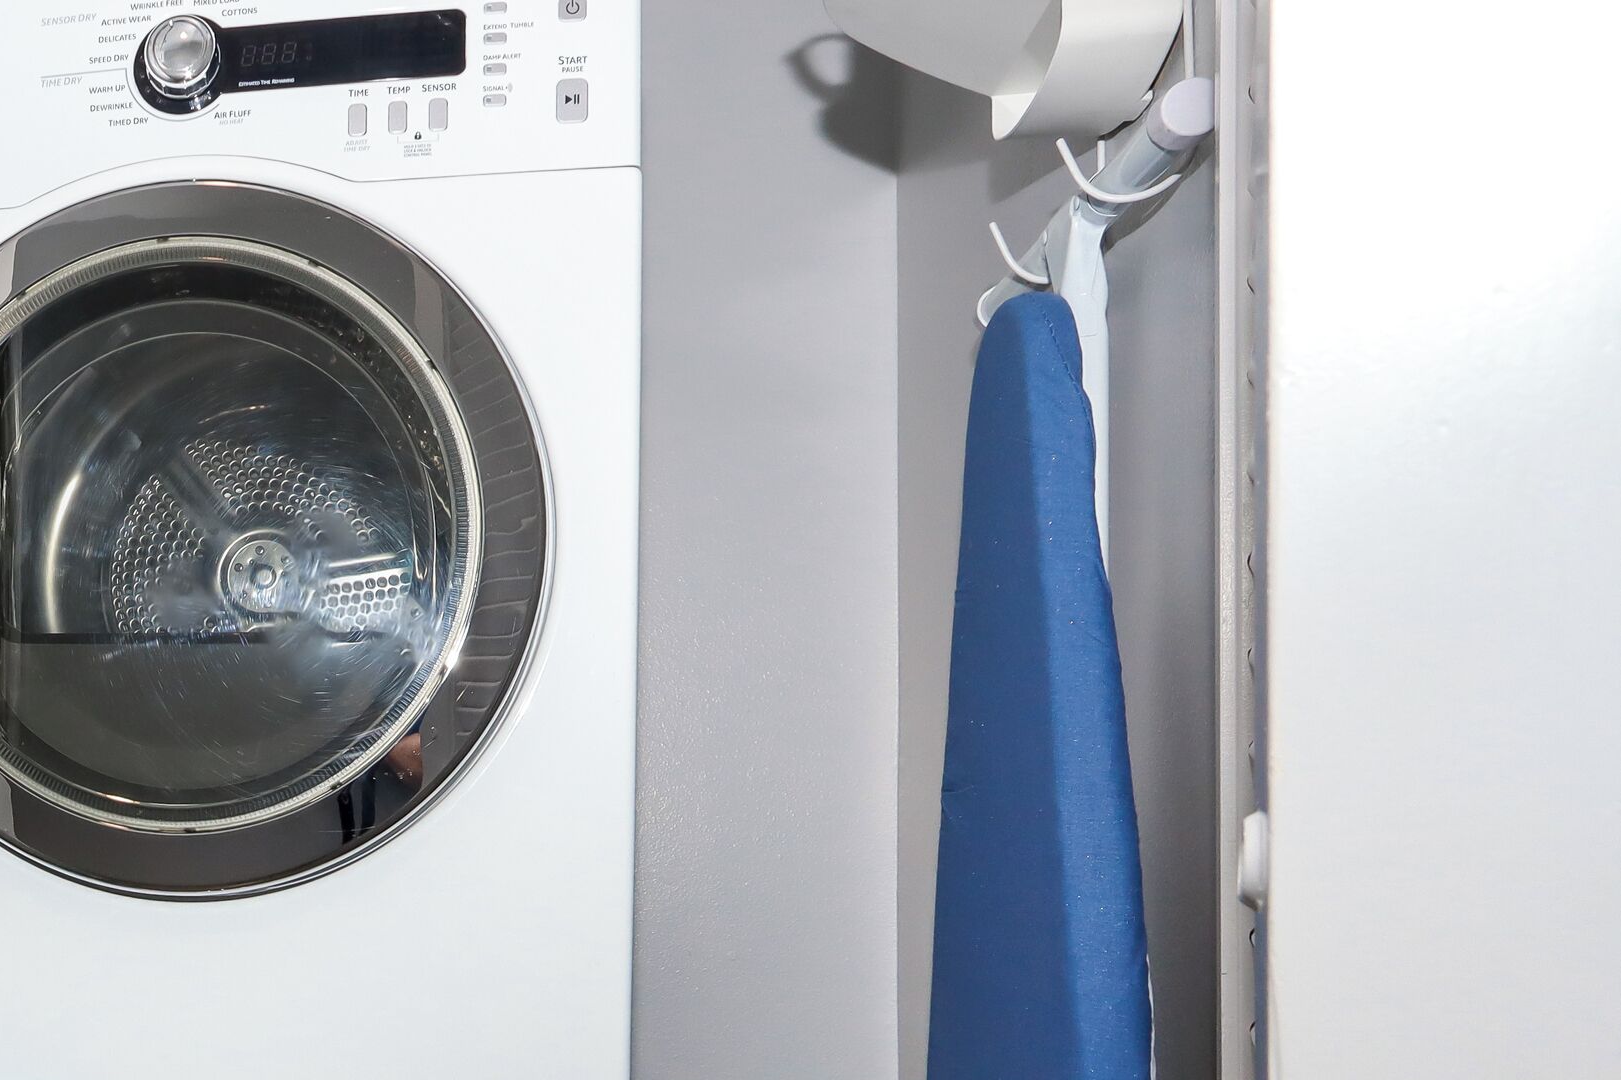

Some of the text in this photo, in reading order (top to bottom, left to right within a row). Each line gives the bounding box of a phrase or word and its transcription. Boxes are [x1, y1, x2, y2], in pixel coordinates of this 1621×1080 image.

[129, 2, 164, 11] WRINKLE
[221, 7, 258, 17] COTTONS
[40, 13, 97, 27] SENSOR DRY
[101, 15, 152, 26] ACTIVE WEAR
[483, 21, 535, 31] EXTEND TUMBLE
[98, 33, 137, 44] DELICATES
[89, 54, 129, 65] SPEED DRY
[502, 52, 522, 60] ALERT
[558, 55, 588, 66] START
[561, 65, 584, 73] PAUSE
[40, 76, 83, 89] TIME DRY
[421, 82, 457, 93] SENSOR
[89, 84, 126, 95] WARM UP
[348, 88, 369, 97] TIME
[387, 85, 411, 95] TEMP
[482, 84, 505, 92] SIGNAL
[89, 102, 133, 112] DEWRINKLE
[214, 109, 252, 120] AIR FLUFF
[108, 117, 149, 127] TIMED DRY
